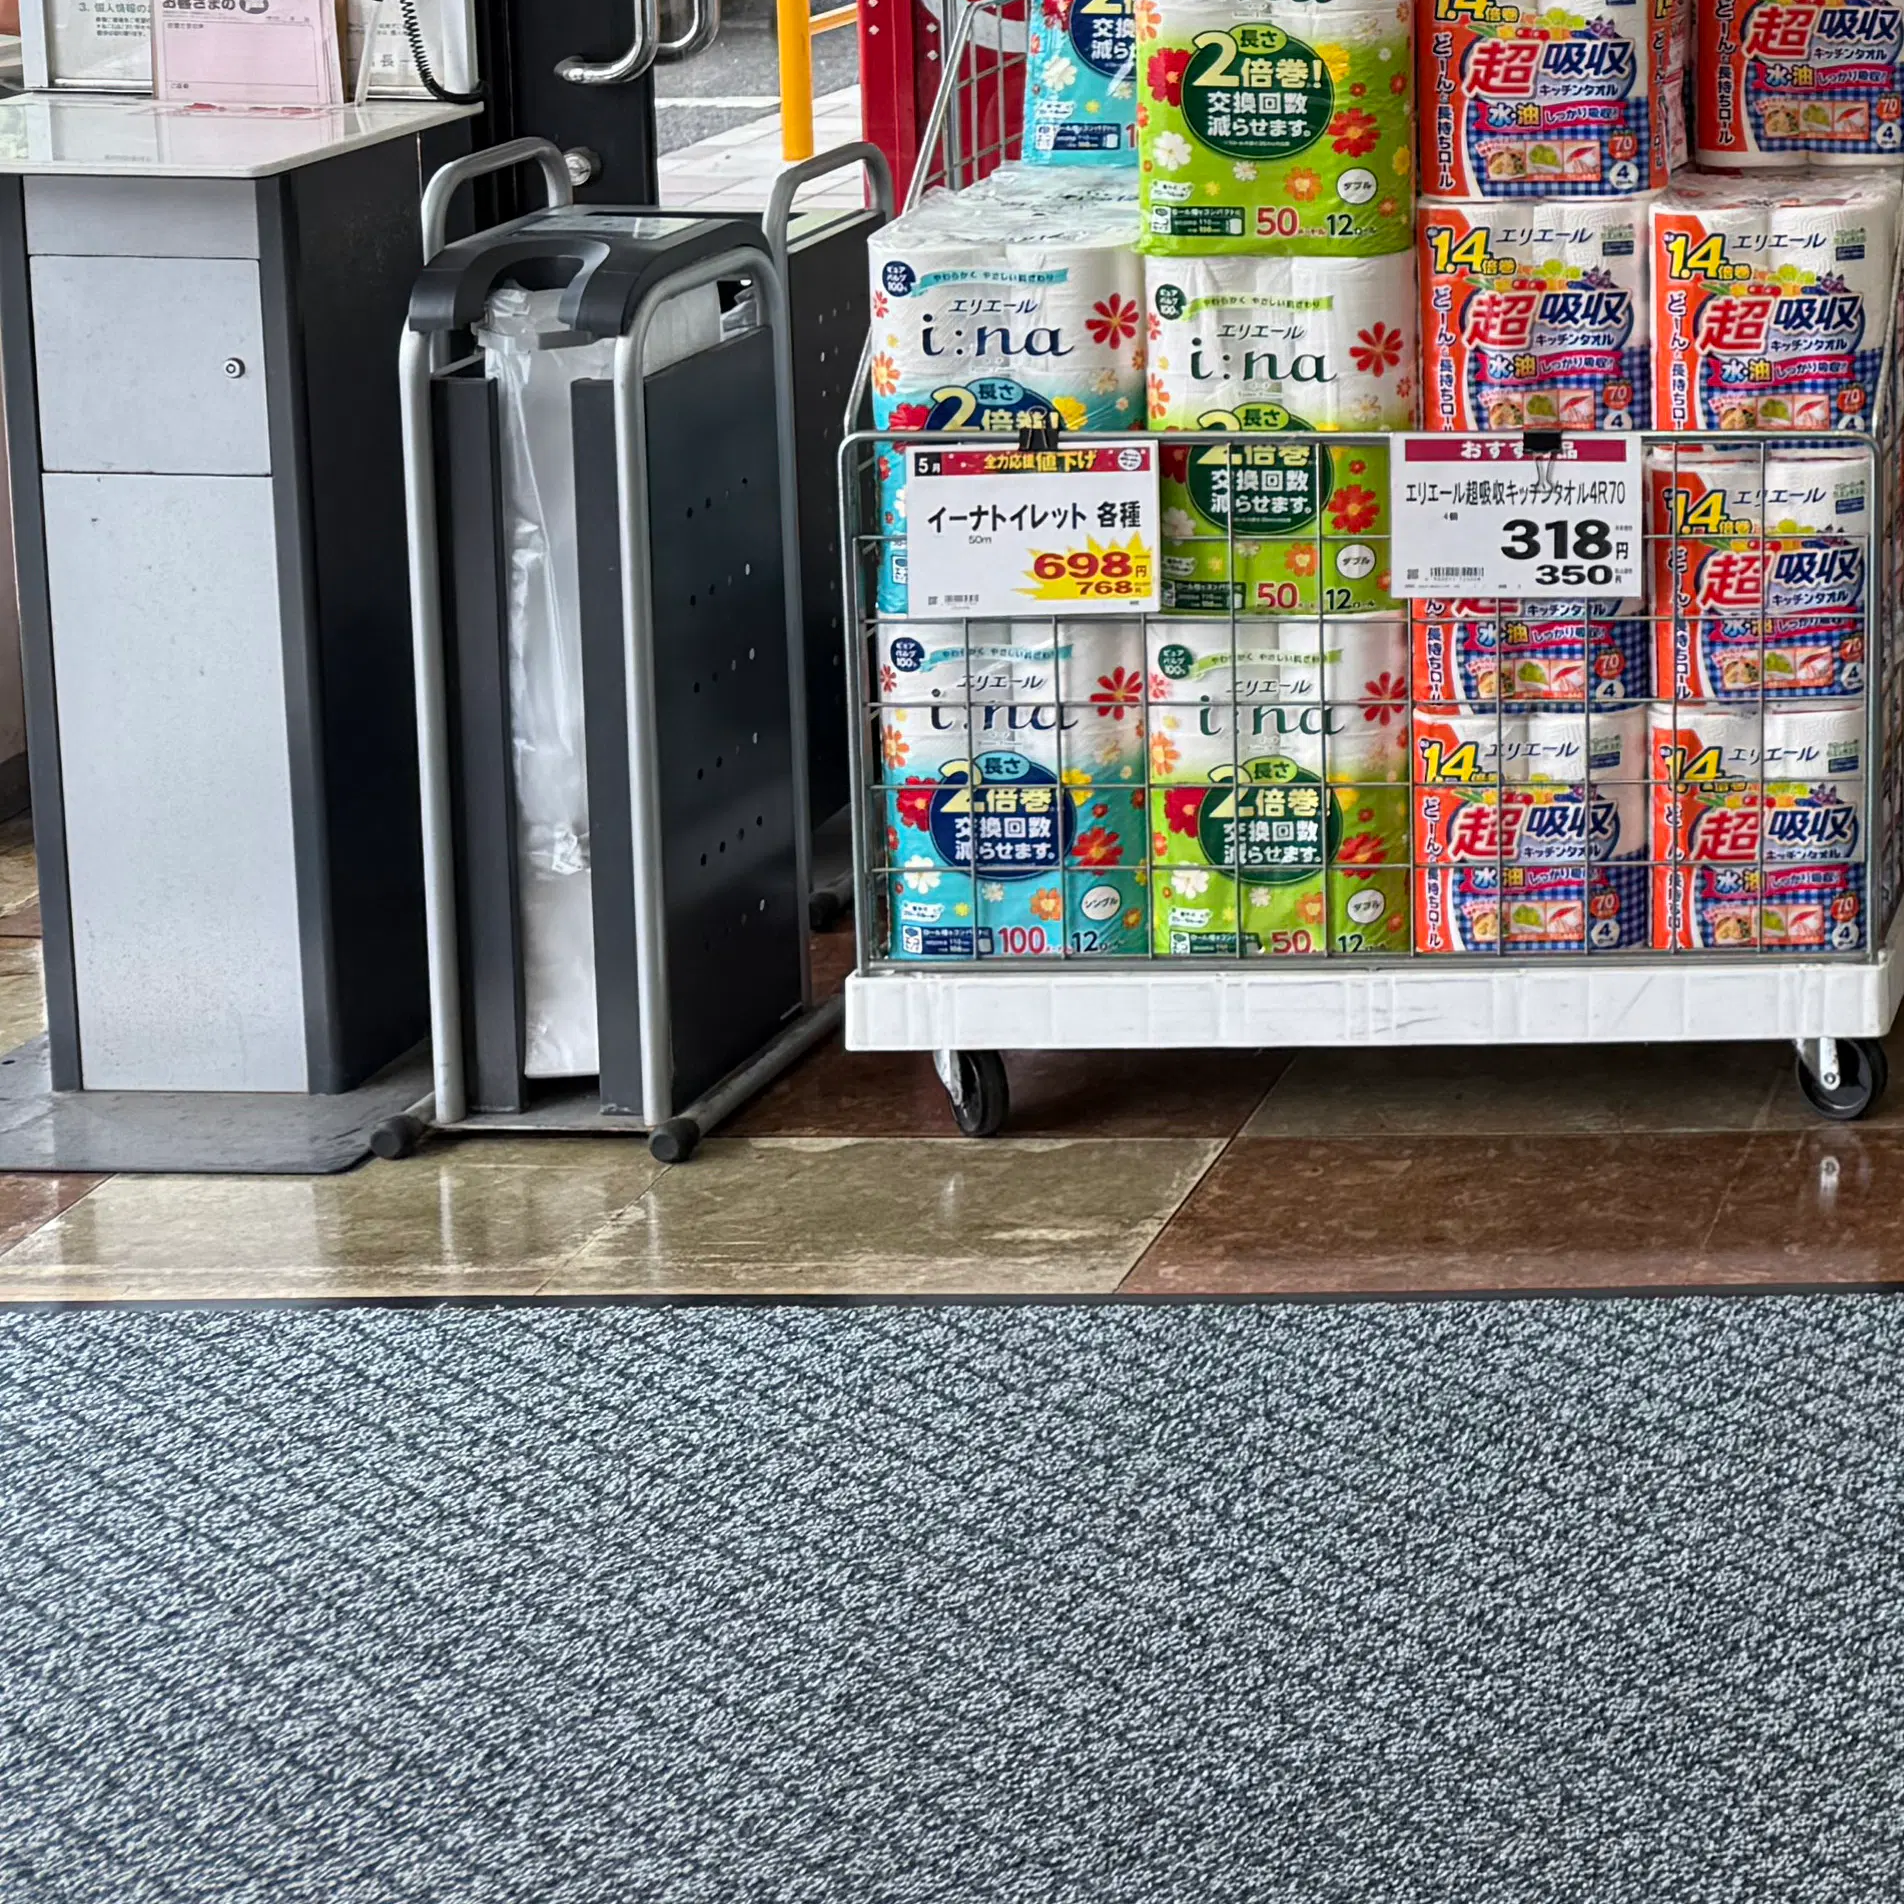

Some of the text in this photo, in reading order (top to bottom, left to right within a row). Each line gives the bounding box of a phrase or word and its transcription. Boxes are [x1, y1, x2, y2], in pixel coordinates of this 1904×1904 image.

[1239, 30, 1277, 49] 長さ
[1813, 45, 1888, 61] キッチンタオル
[1539, 84, 1618, 97] キッチンタオル
[1207, 92, 1308, 116] 交換回数
[1207, 118, 1313, 139] 減らせます。
[1496, 226, 1593, 245] エリエール
[1731, 232, 1826, 251] エリエール
[948, 297, 1037, 314] エリエール
[1216, 324, 1305, 340] エリエール
[1535, 332, 1614, 347] キッチンタオル
[1770, 337, 1848, 353] キッチンタオル
[978, 382, 1015, 401] 長さ
[927, 500, 1141, 533] イーナトイレット 各種
[1076, 581, 1134, 595] 768
[956, 674, 1045, 691] エリエール
[955, 818, 1052, 840] 交換回数
